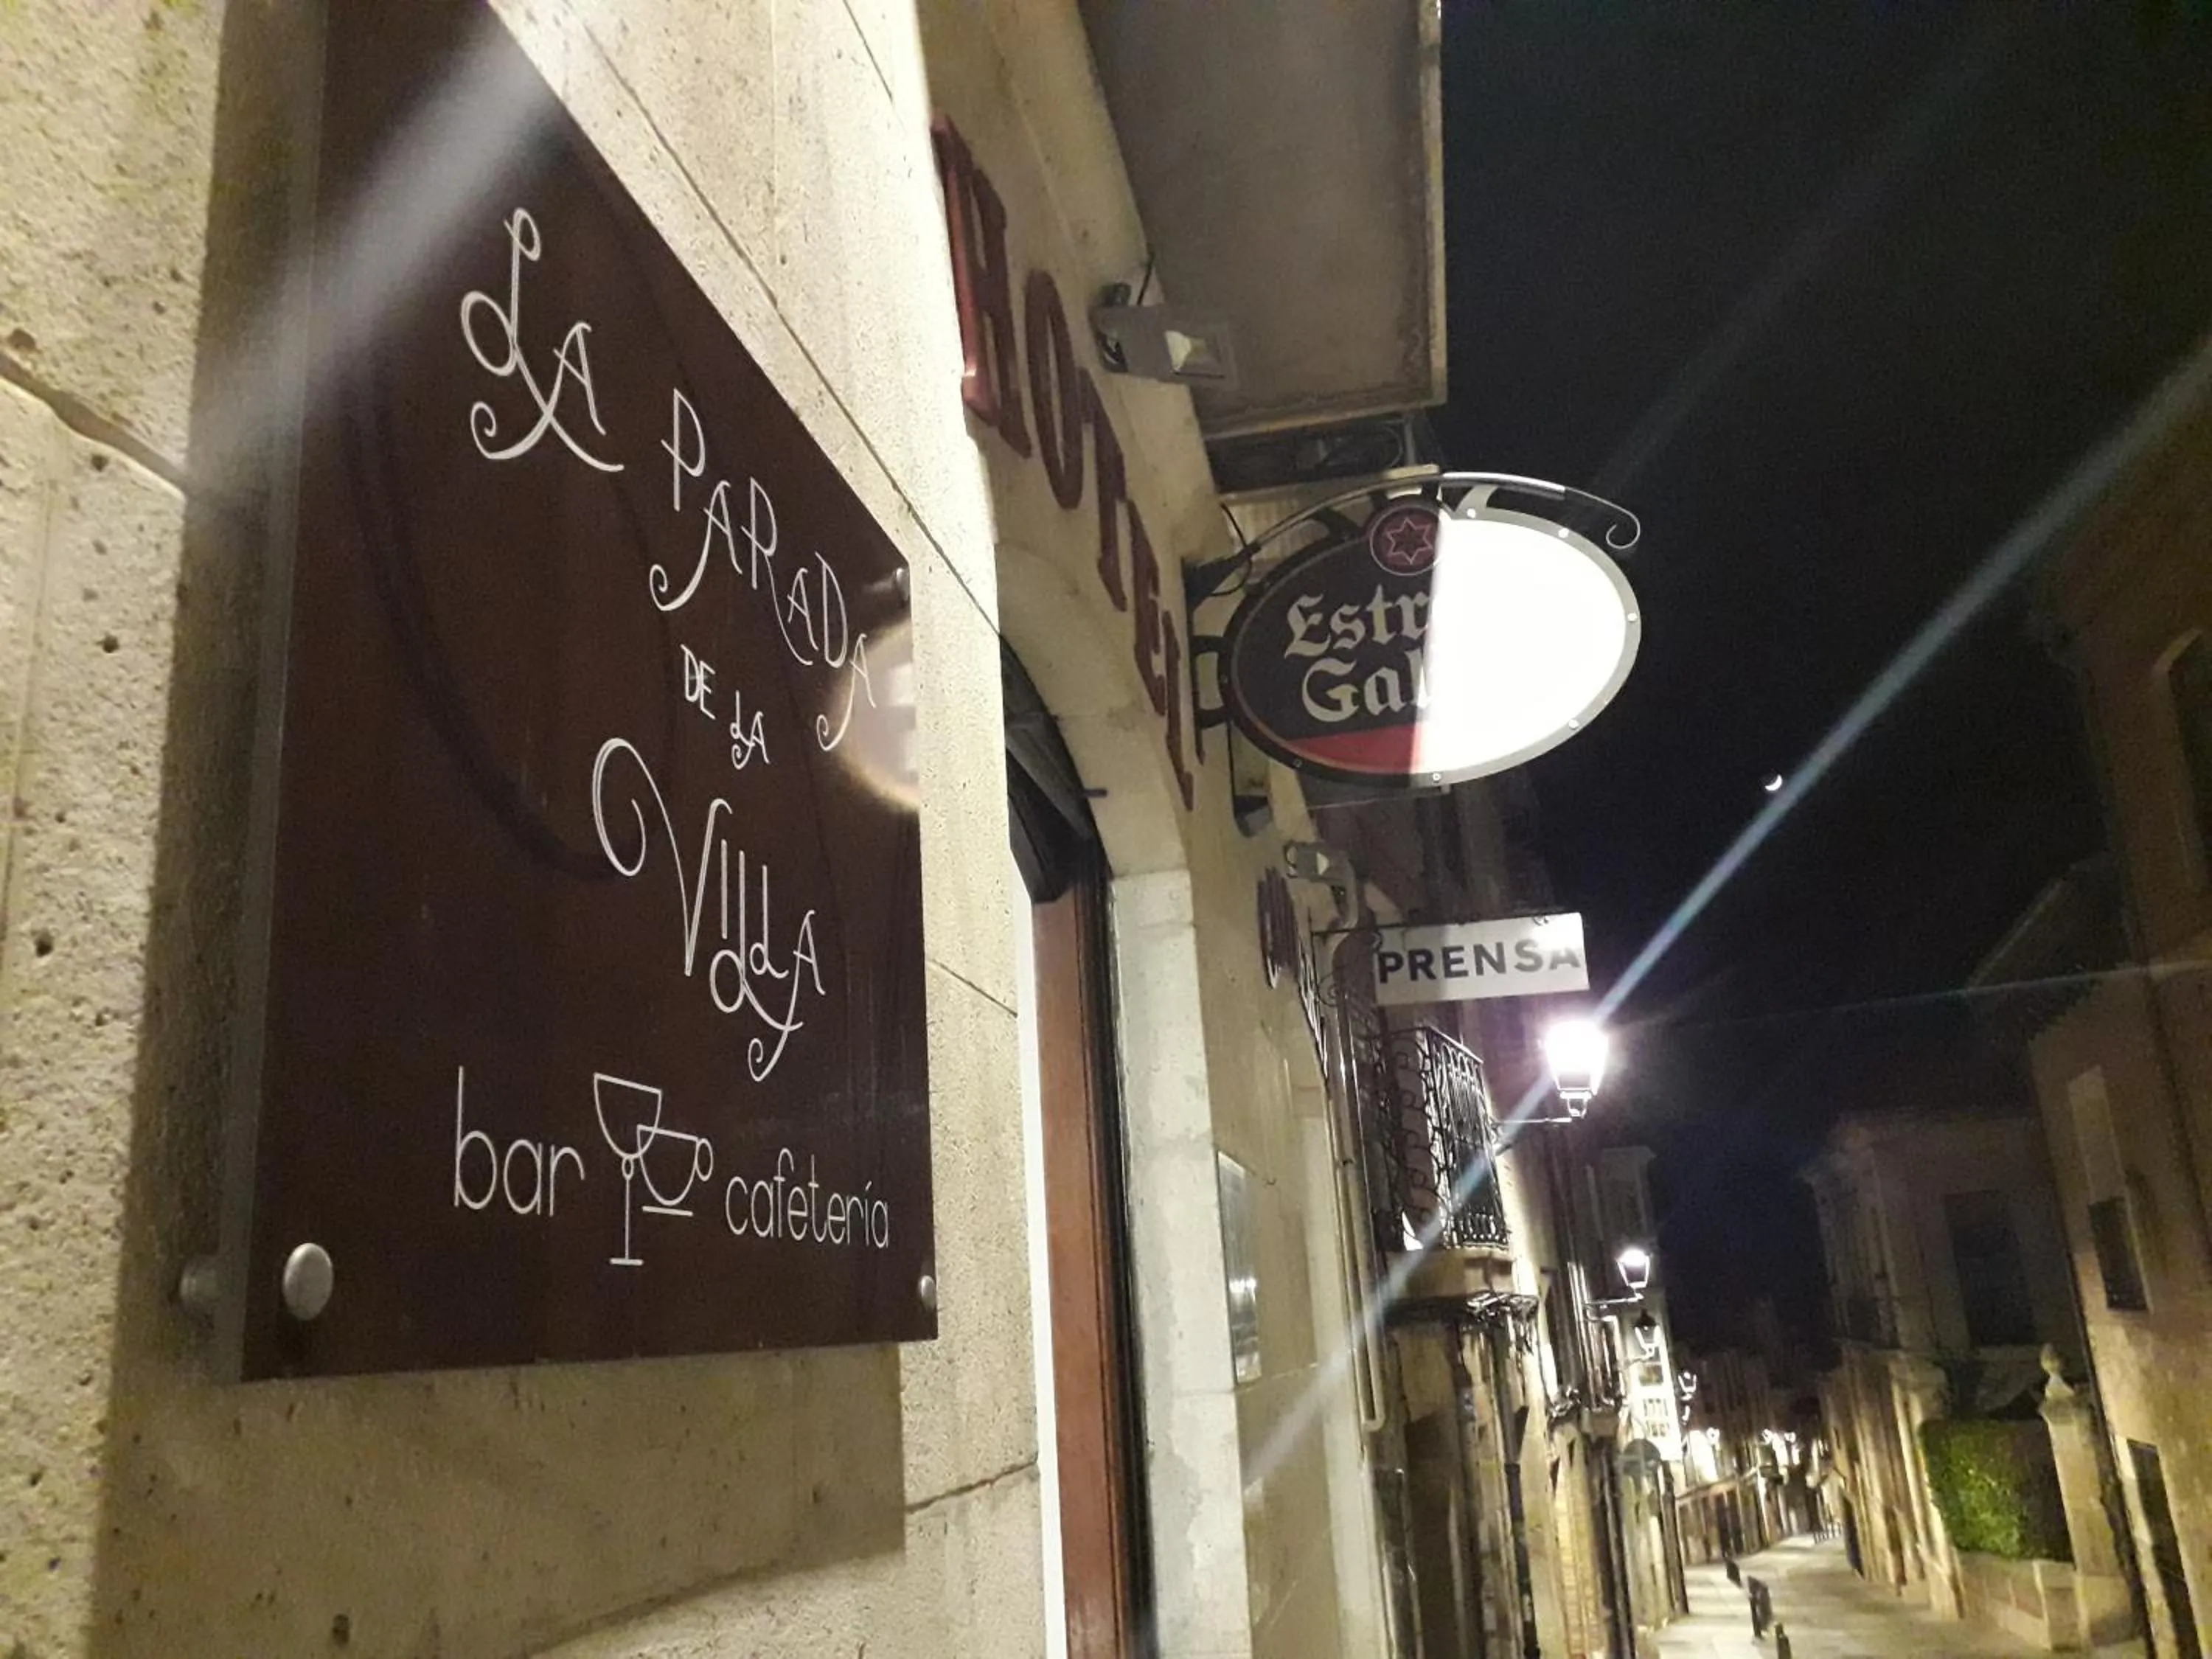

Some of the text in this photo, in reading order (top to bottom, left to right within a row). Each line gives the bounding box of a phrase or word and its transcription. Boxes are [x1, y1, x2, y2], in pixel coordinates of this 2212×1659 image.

[930, 114, 1194, 812] HOTEL
[649, 388, 877, 752] PARADA
[1284, 584, 1431, 659] Estr
[680, 643, 717, 720] DE
[1301, 647, 1431, 723] Gal
[1377, 939, 1582, 985] PRENSA
[453, 1065, 889, 1248] bar cafetería
